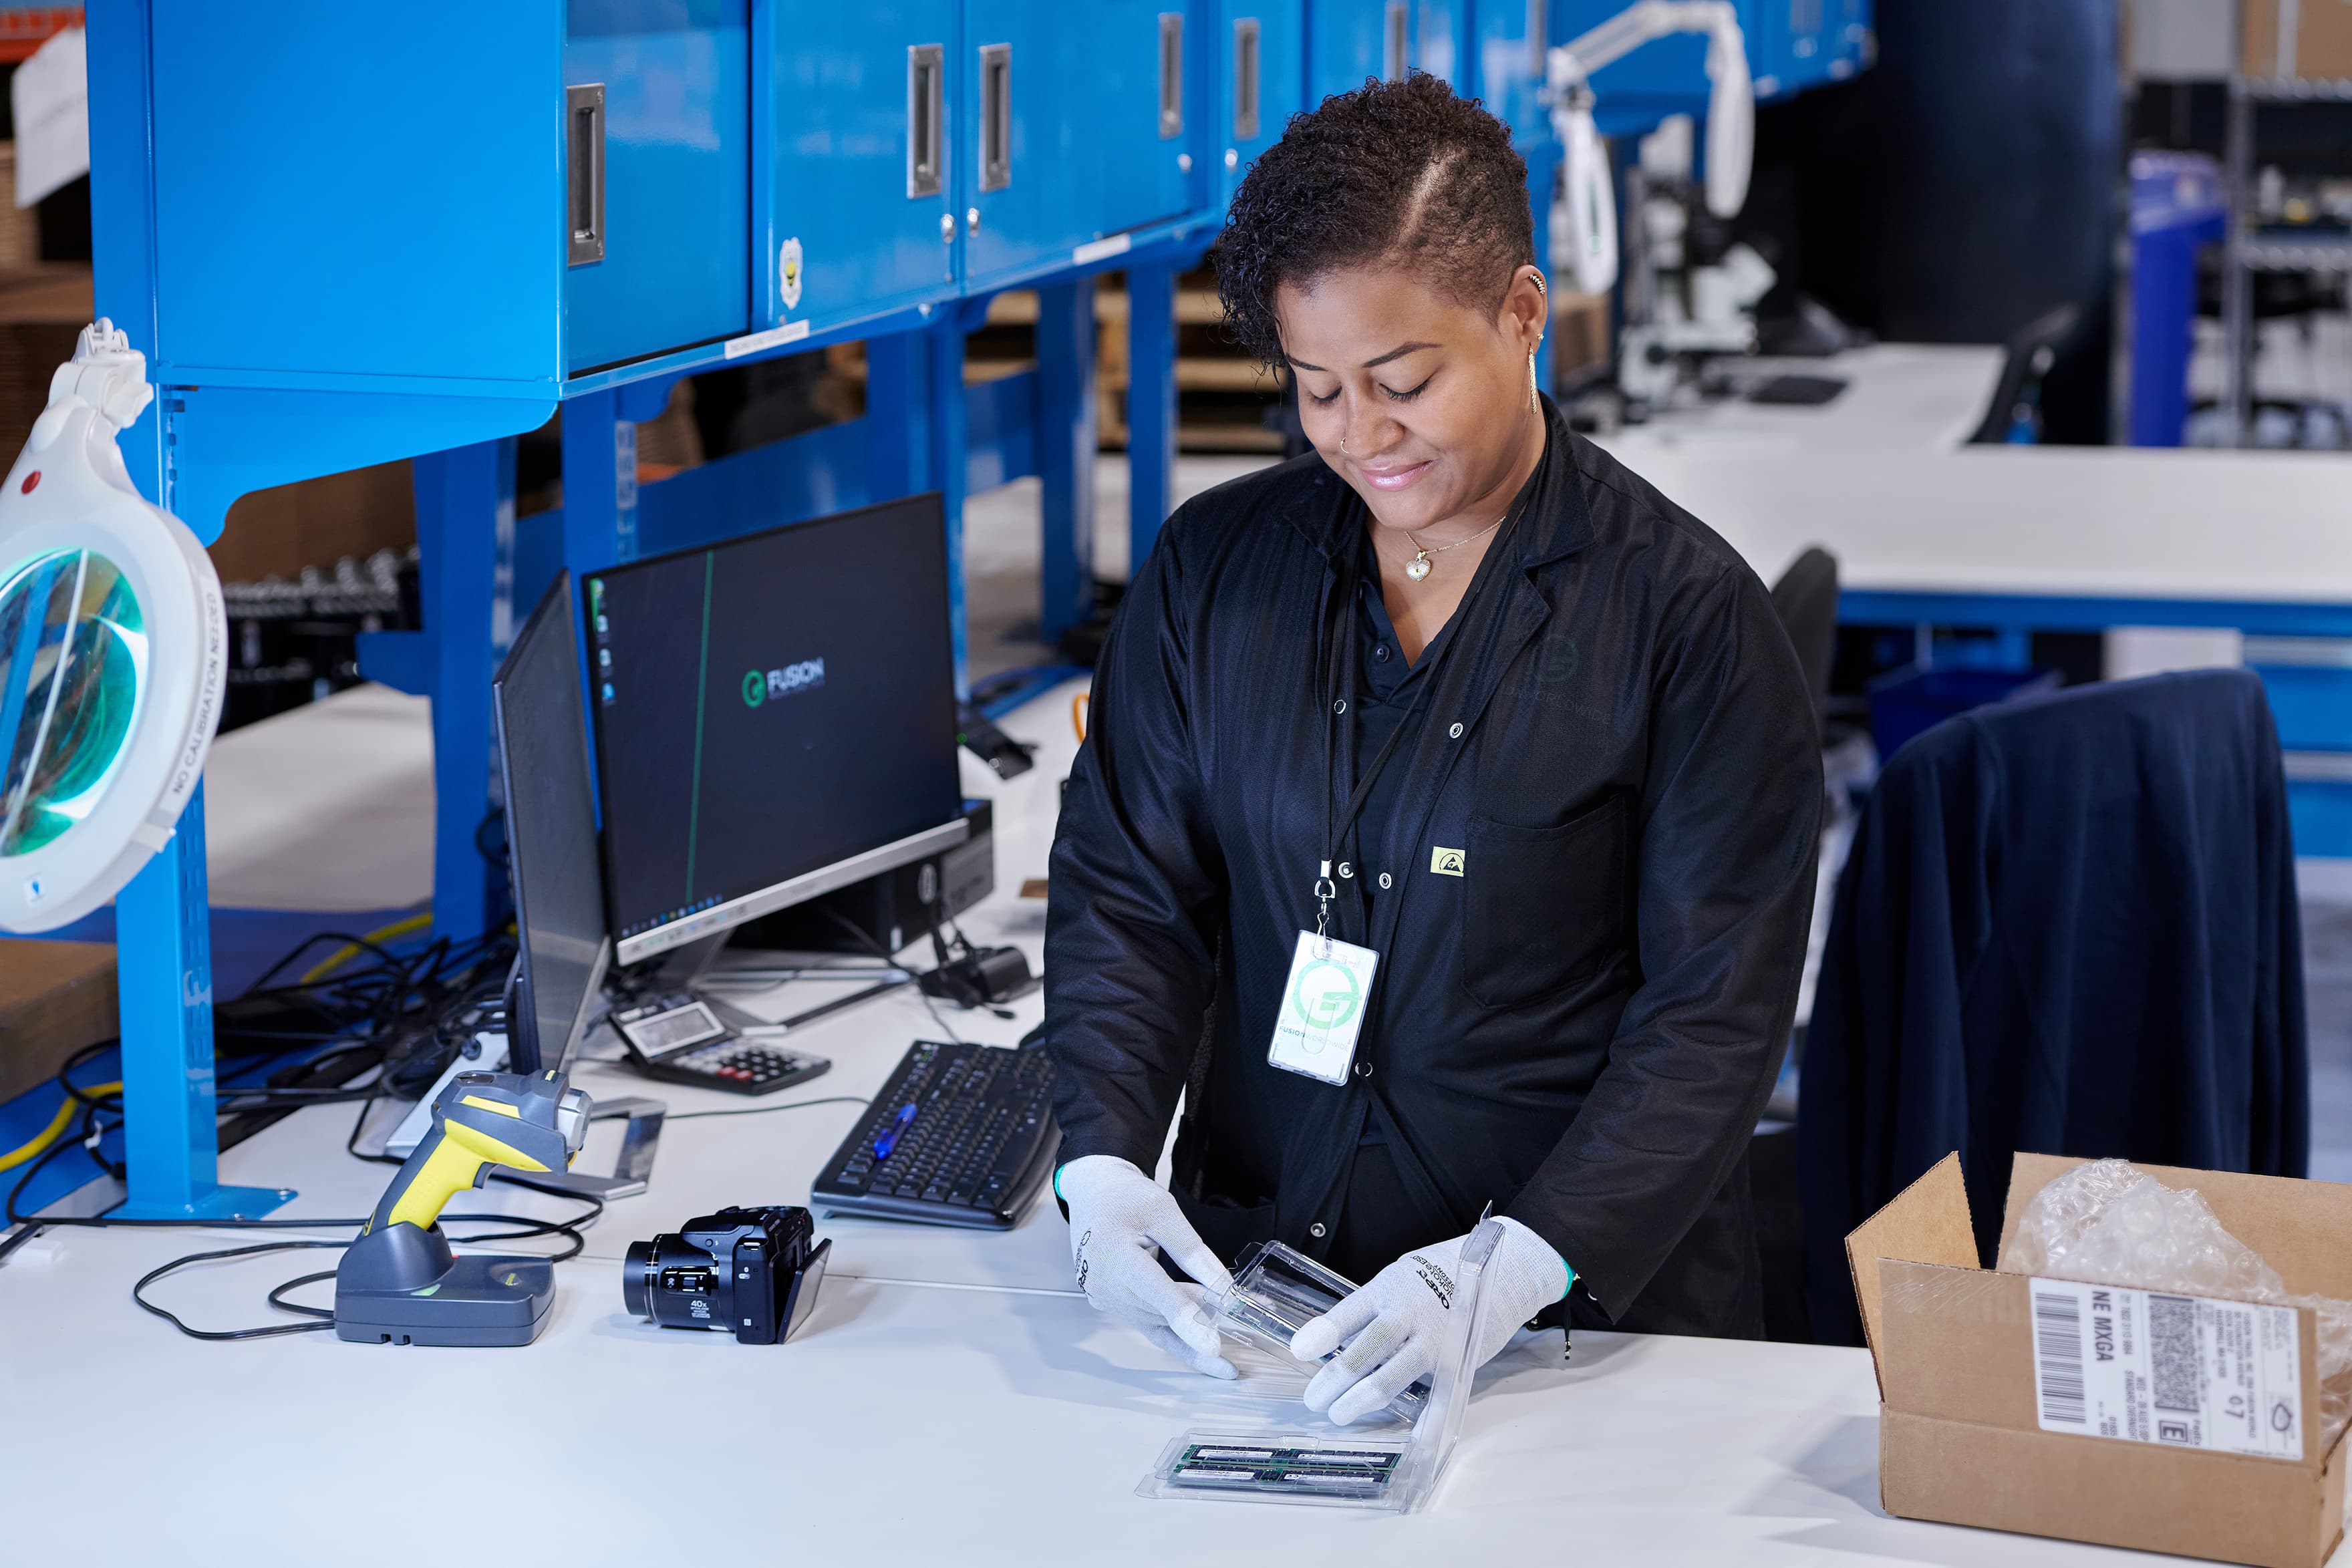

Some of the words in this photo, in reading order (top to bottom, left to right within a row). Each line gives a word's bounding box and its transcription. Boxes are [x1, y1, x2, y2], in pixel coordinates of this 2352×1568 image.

[767, 657, 825, 695] FUSION
[173, 768, 190, 796] NO
[187, 655, 218, 769] CALIBRATION
[208, 591, 219, 655] NEEDED
[1279, 1026, 1306, 1038] FUSION
[2092, 1291, 2111, 1311] NE
[2093, 1317, 2114, 1362] MXGA
[2216, 1309, 2224, 1344] HAVERHILL
[2125, 1370, 2135, 1403] STANDARD
[2136, 1377, 2146, 1391] WED
[2101, 1422, 2109, 1436] BOS
[2109, 1417, 2117, 1436] 01835
[2127, 1405, 2138, 1440] OVERNIGHT
[2138, 1410, 2148, 1423] AUG
[2193, 1419, 2202, 1446] FedEx
